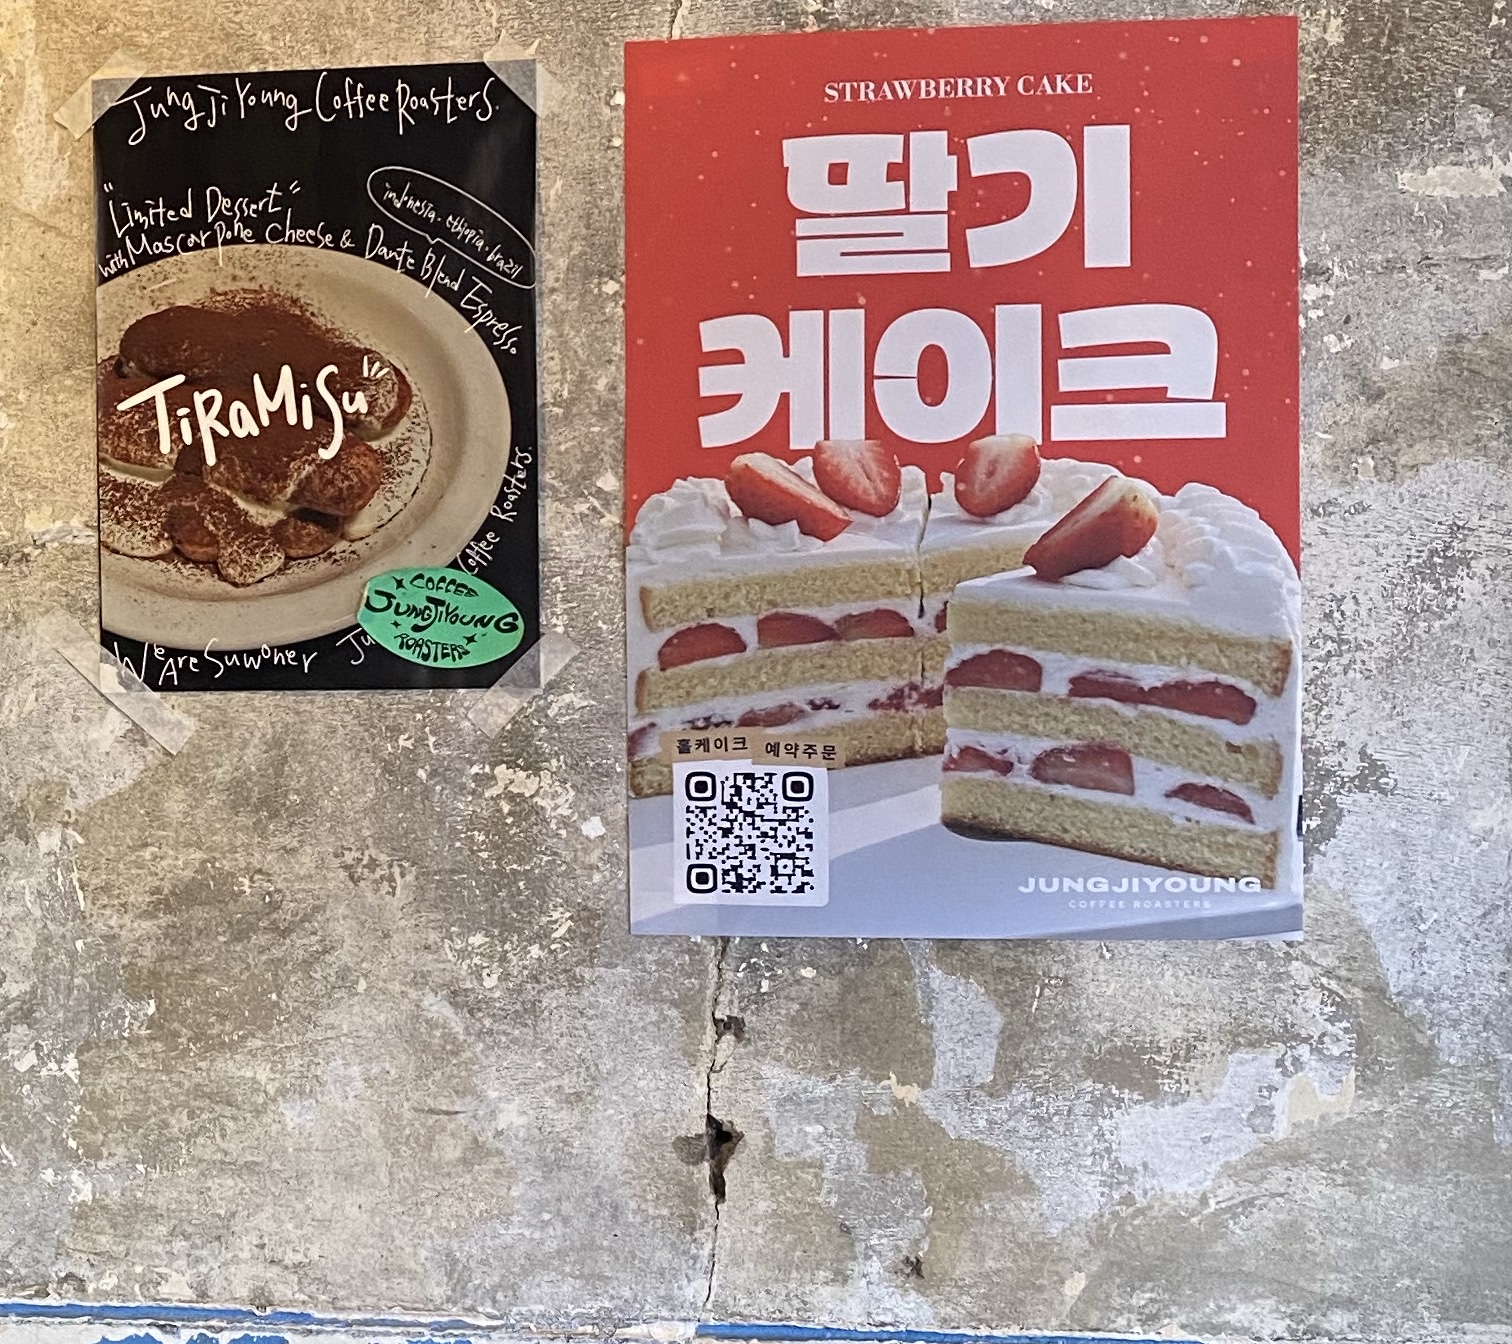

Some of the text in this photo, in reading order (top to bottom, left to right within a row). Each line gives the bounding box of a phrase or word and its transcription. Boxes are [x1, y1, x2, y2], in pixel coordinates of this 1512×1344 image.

[316, 71, 390, 122] Coffee
[824, 72, 1094, 103] STRAWBERRY CAKE
[782, 124, 1131, 277] 딸기
[98, 244, 130, 278] with
[339, 229, 356, 249] &
[365, 223, 415, 274] Dante
[419, 246, 466, 298] Blend
[698, 303, 1227, 450] 케이크
[456, 529, 501, 576] Coffee
[114, 642, 166, 683] We
[765, 741, 837, 761] 예약주문
[1018, 875, 1262, 894] JUNGJIYOUNG
[1068, 898, 1212, 910] COFFEE ROASTERS
